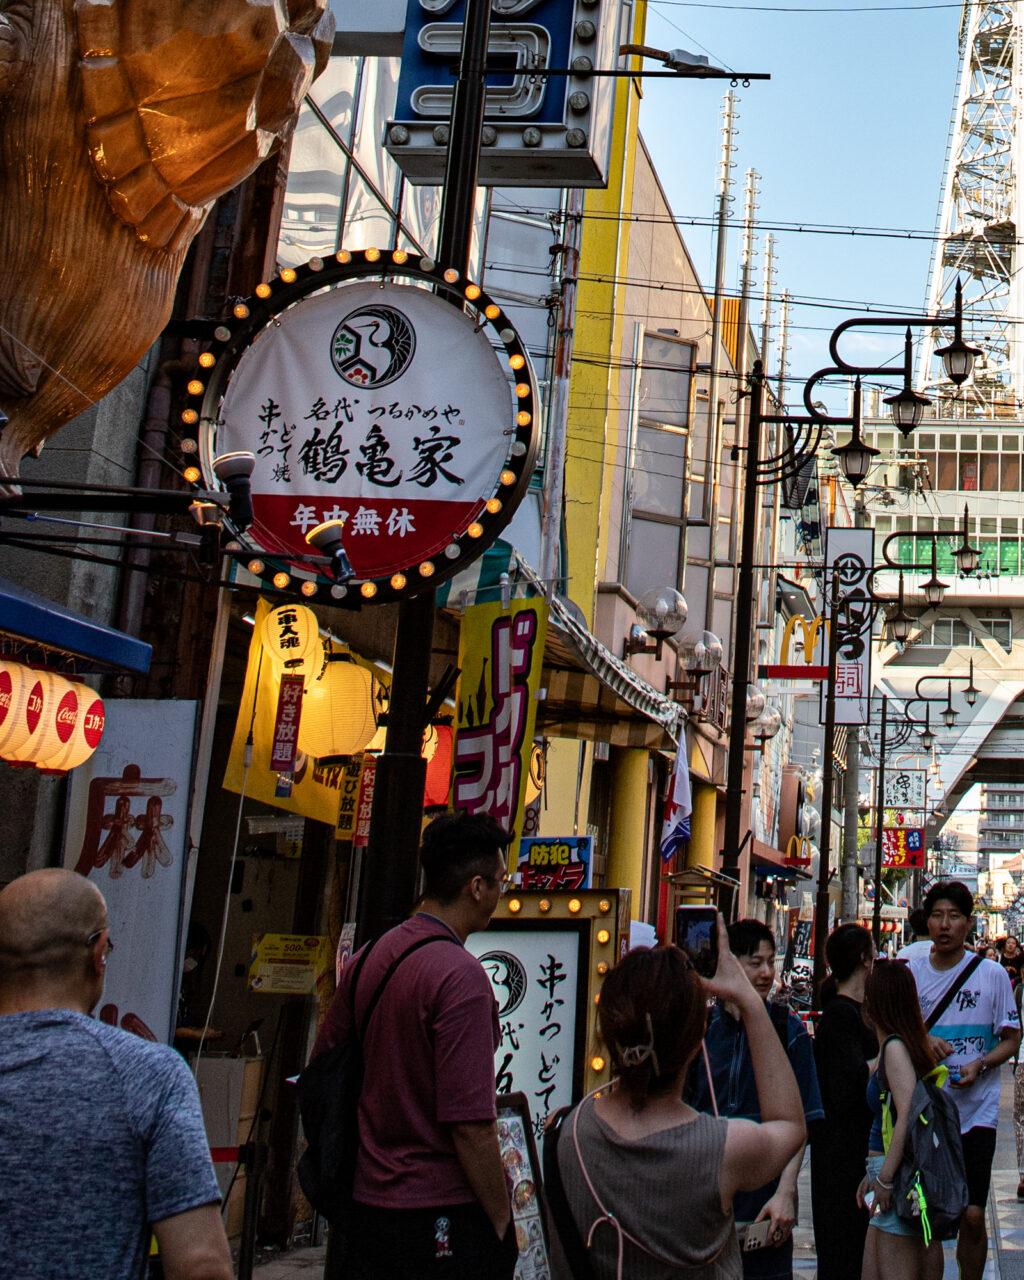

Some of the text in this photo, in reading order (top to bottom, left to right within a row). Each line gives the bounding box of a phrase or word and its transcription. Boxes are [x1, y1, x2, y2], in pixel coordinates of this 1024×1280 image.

[256, 397, 282, 459] 串かつ
[302, 398, 361, 423] 名代
[366, 401, 462, 424] つるかめや
[296, 424, 467, 490] 鶴亀家
[288, 502, 418, 538] 年中無休
[271, 683, 303, 763] 好き放題
[338, 759, 362, 832] 遊び放題
[354, 766, 377, 838] 好き放題
[530, 844, 570, 866] 防犯
[536, 953, 568, 1042] 串かつ
